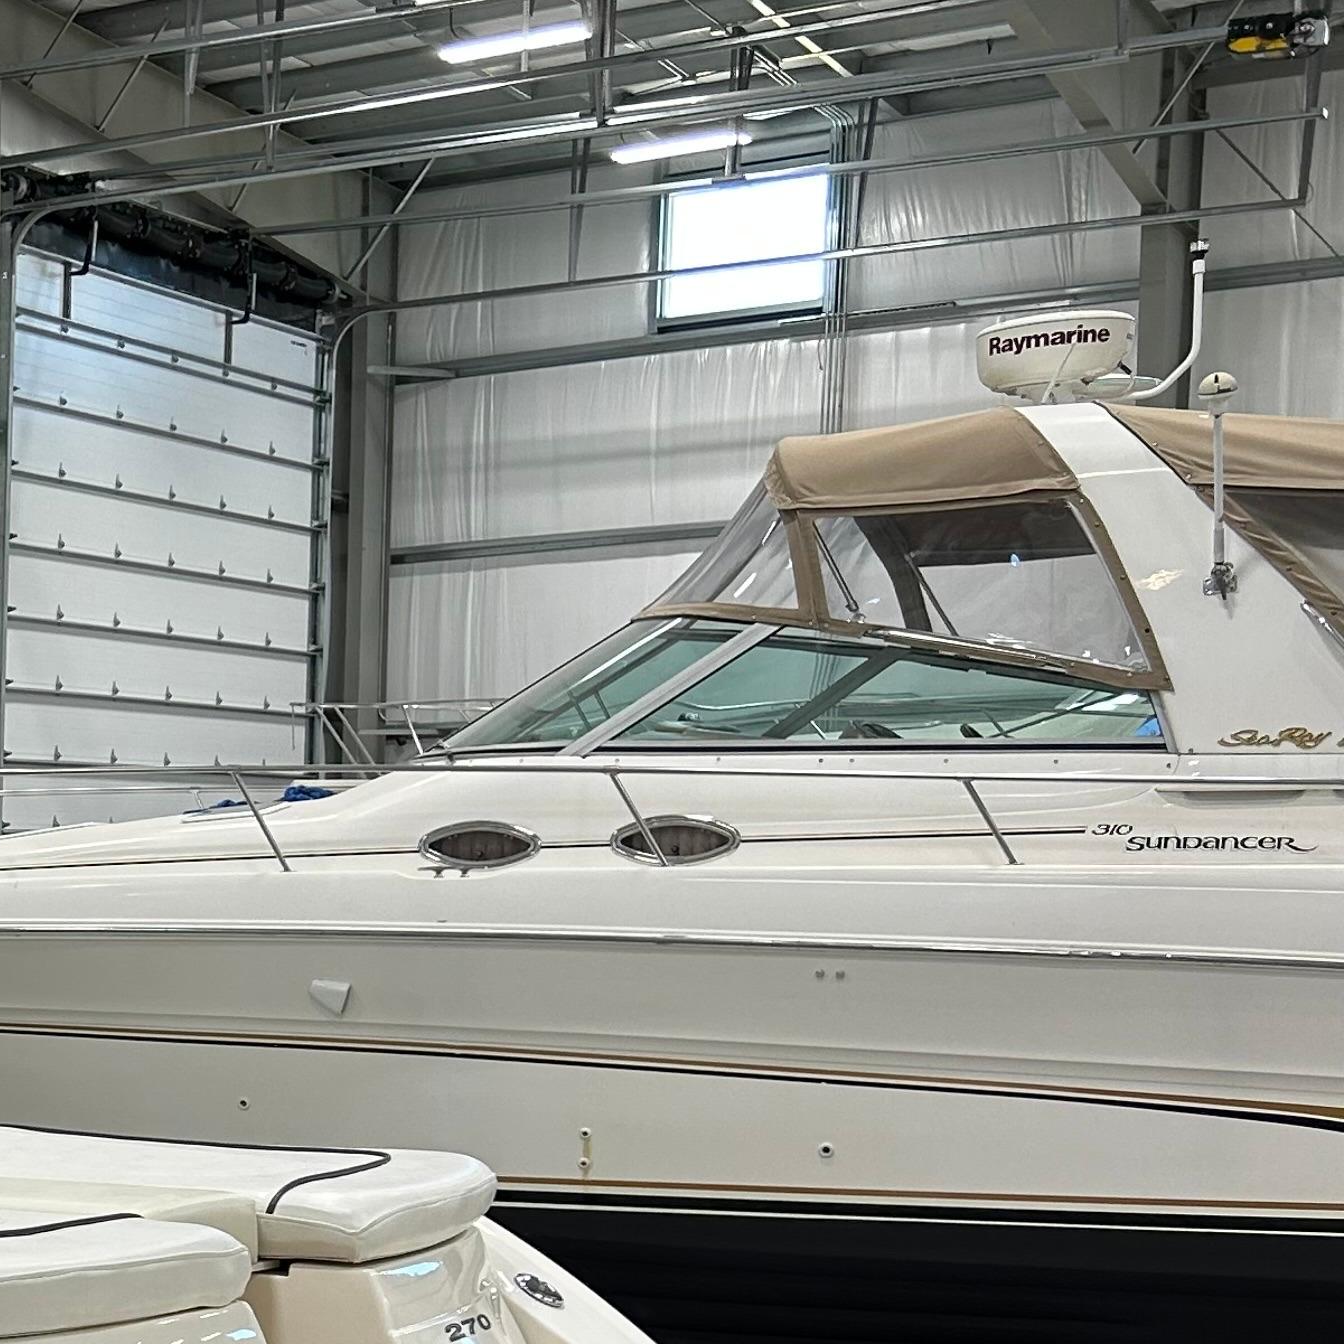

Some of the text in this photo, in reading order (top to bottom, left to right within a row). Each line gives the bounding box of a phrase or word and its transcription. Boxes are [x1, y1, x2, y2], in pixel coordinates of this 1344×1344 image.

[989, 324, 1111, 357] Raymarine
[1092, 824, 1133, 836] 310
[445, 1314, 491, 1342] 270
